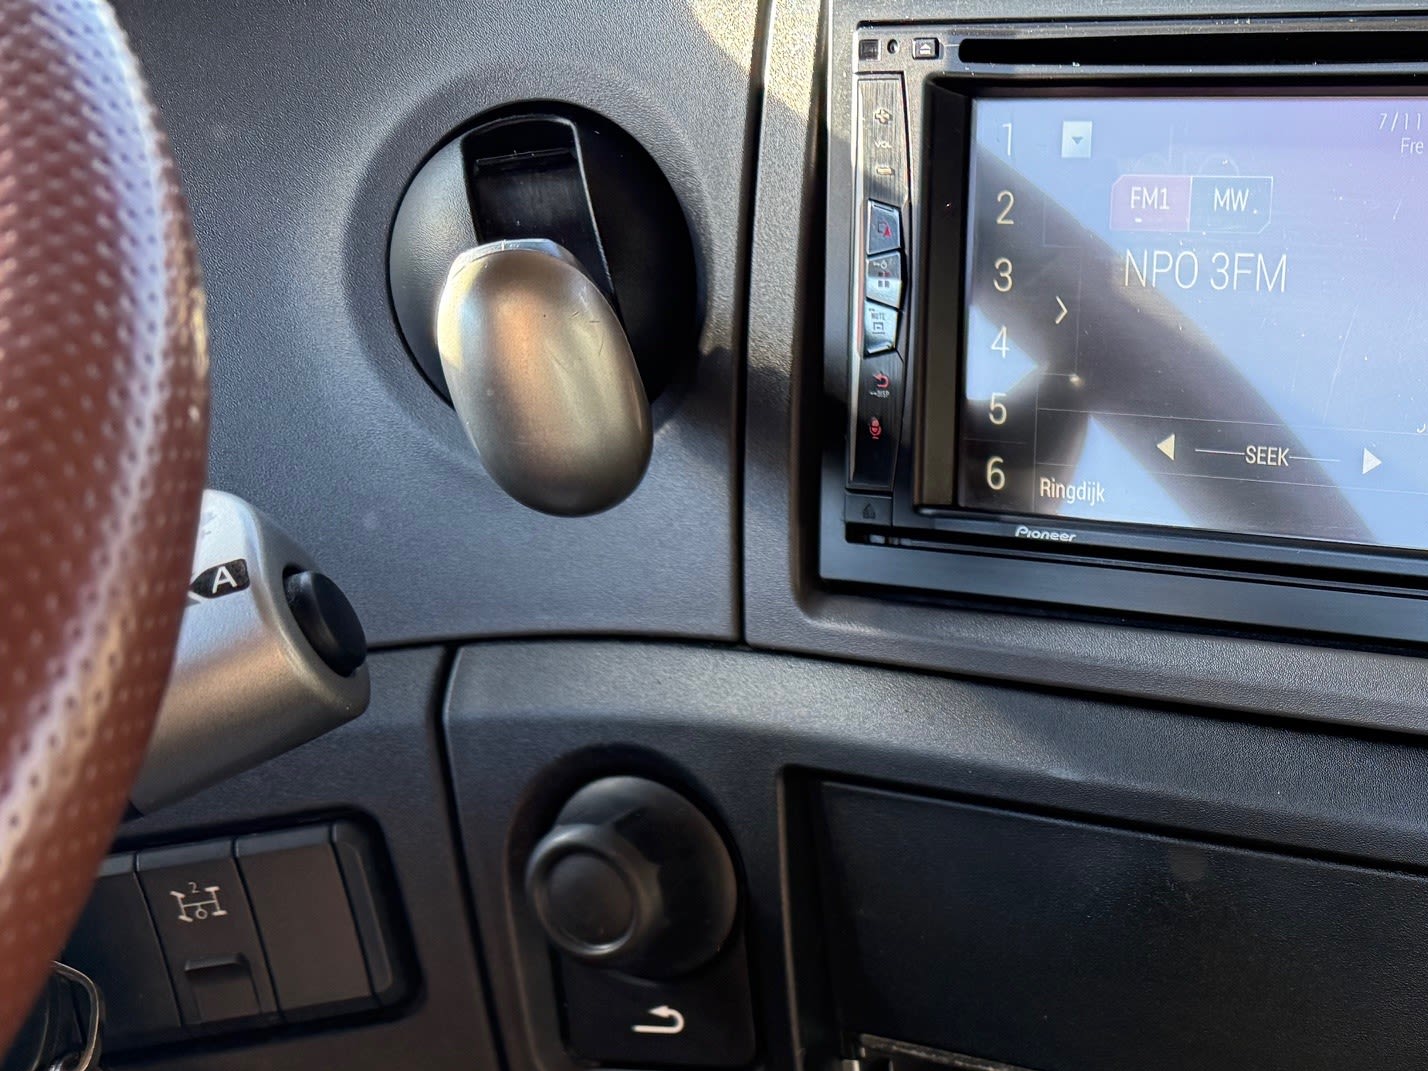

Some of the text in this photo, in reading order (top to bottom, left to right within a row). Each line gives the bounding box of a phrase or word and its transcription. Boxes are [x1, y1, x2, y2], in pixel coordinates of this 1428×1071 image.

[1379, 112, 1421, 132] 7/11
[1002, 122, 1013, 157] 1
[1400, 138, 1424, 154] Fre
[996, 190, 1015, 225] 2
[1130, 186, 1170, 210] FM1
[1213, 187, 1249, 212] MW
[993, 257, 1013, 292] 3
[1124, 248, 1287, 293] NPO 3FM
[990, 325, 1010, 359] 4
[989, 391, 1007, 425] 5
[1245, 444, 1289, 467] SEEK
[986, 456, 1006, 490] 6
[1040, 476, 1105, 506] Ringdijk
[1014, 525, 1077, 542] Pioneer
[212, 565, 238, 593] A
